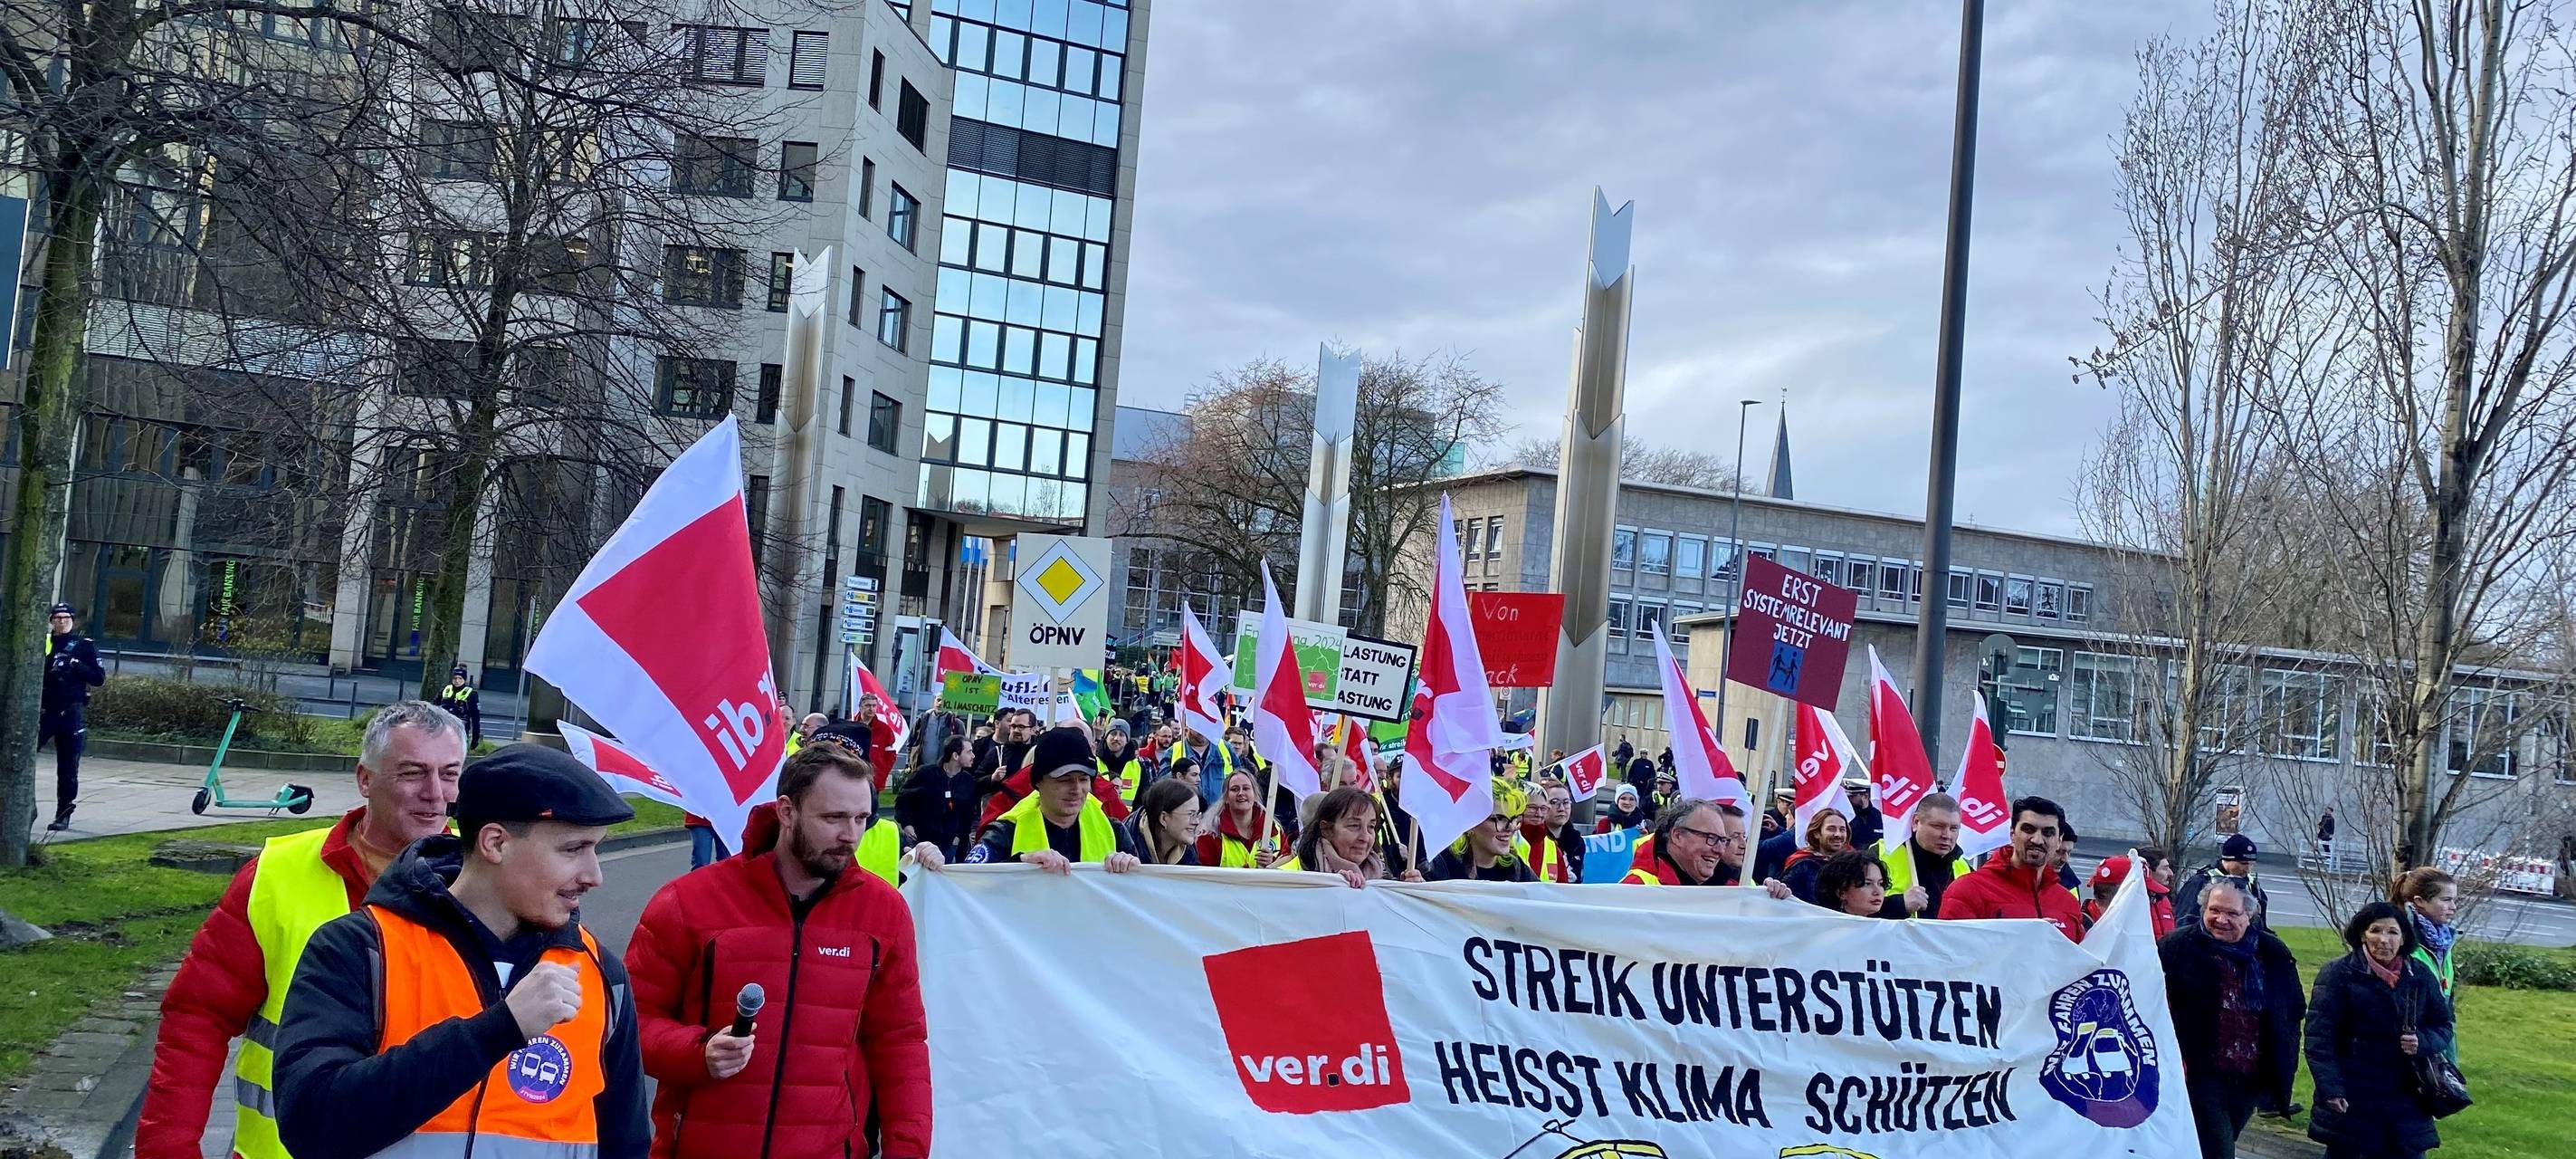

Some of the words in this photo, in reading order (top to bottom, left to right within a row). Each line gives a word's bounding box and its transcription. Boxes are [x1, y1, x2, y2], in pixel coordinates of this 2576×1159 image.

[1781, 573, 1823, 608] ERST
[1481, 598, 1519, 621] Von
[1743, 589, 1852, 642] SYSTEMRELEVANT
[1029, 622, 1086, 646] ÖPNV
[1772, 623, 1814, 649] JETZT
[1343, 645, 1407, 668] LASTUNG
[965, 686, 979, 694] IST
[1337, 689, 1393, 712] ASTUNG
[817, 946, 851, 958] ver.di
[1463, 936, 1647, 1020] STREIK
[1652, 959, 2002, 1050] UNTERSTÜTZEN
[2055, 979, 2094, 1034] FAHREN
[2092, 973, 2157, 1067] ZUSAMMEN
[510, 1053, 520, 1070] WIR
[549, 1039, 569, 1086] ZUSAMMEN
[1240, 1042, 1391, 1087] ver.di
[1434, 1040, 1610, 1118] HEISST
[1614, 1060, 1774, 1129] KLIMA
[1805, 1061, 2018, 1135] SCHÜTZEN
